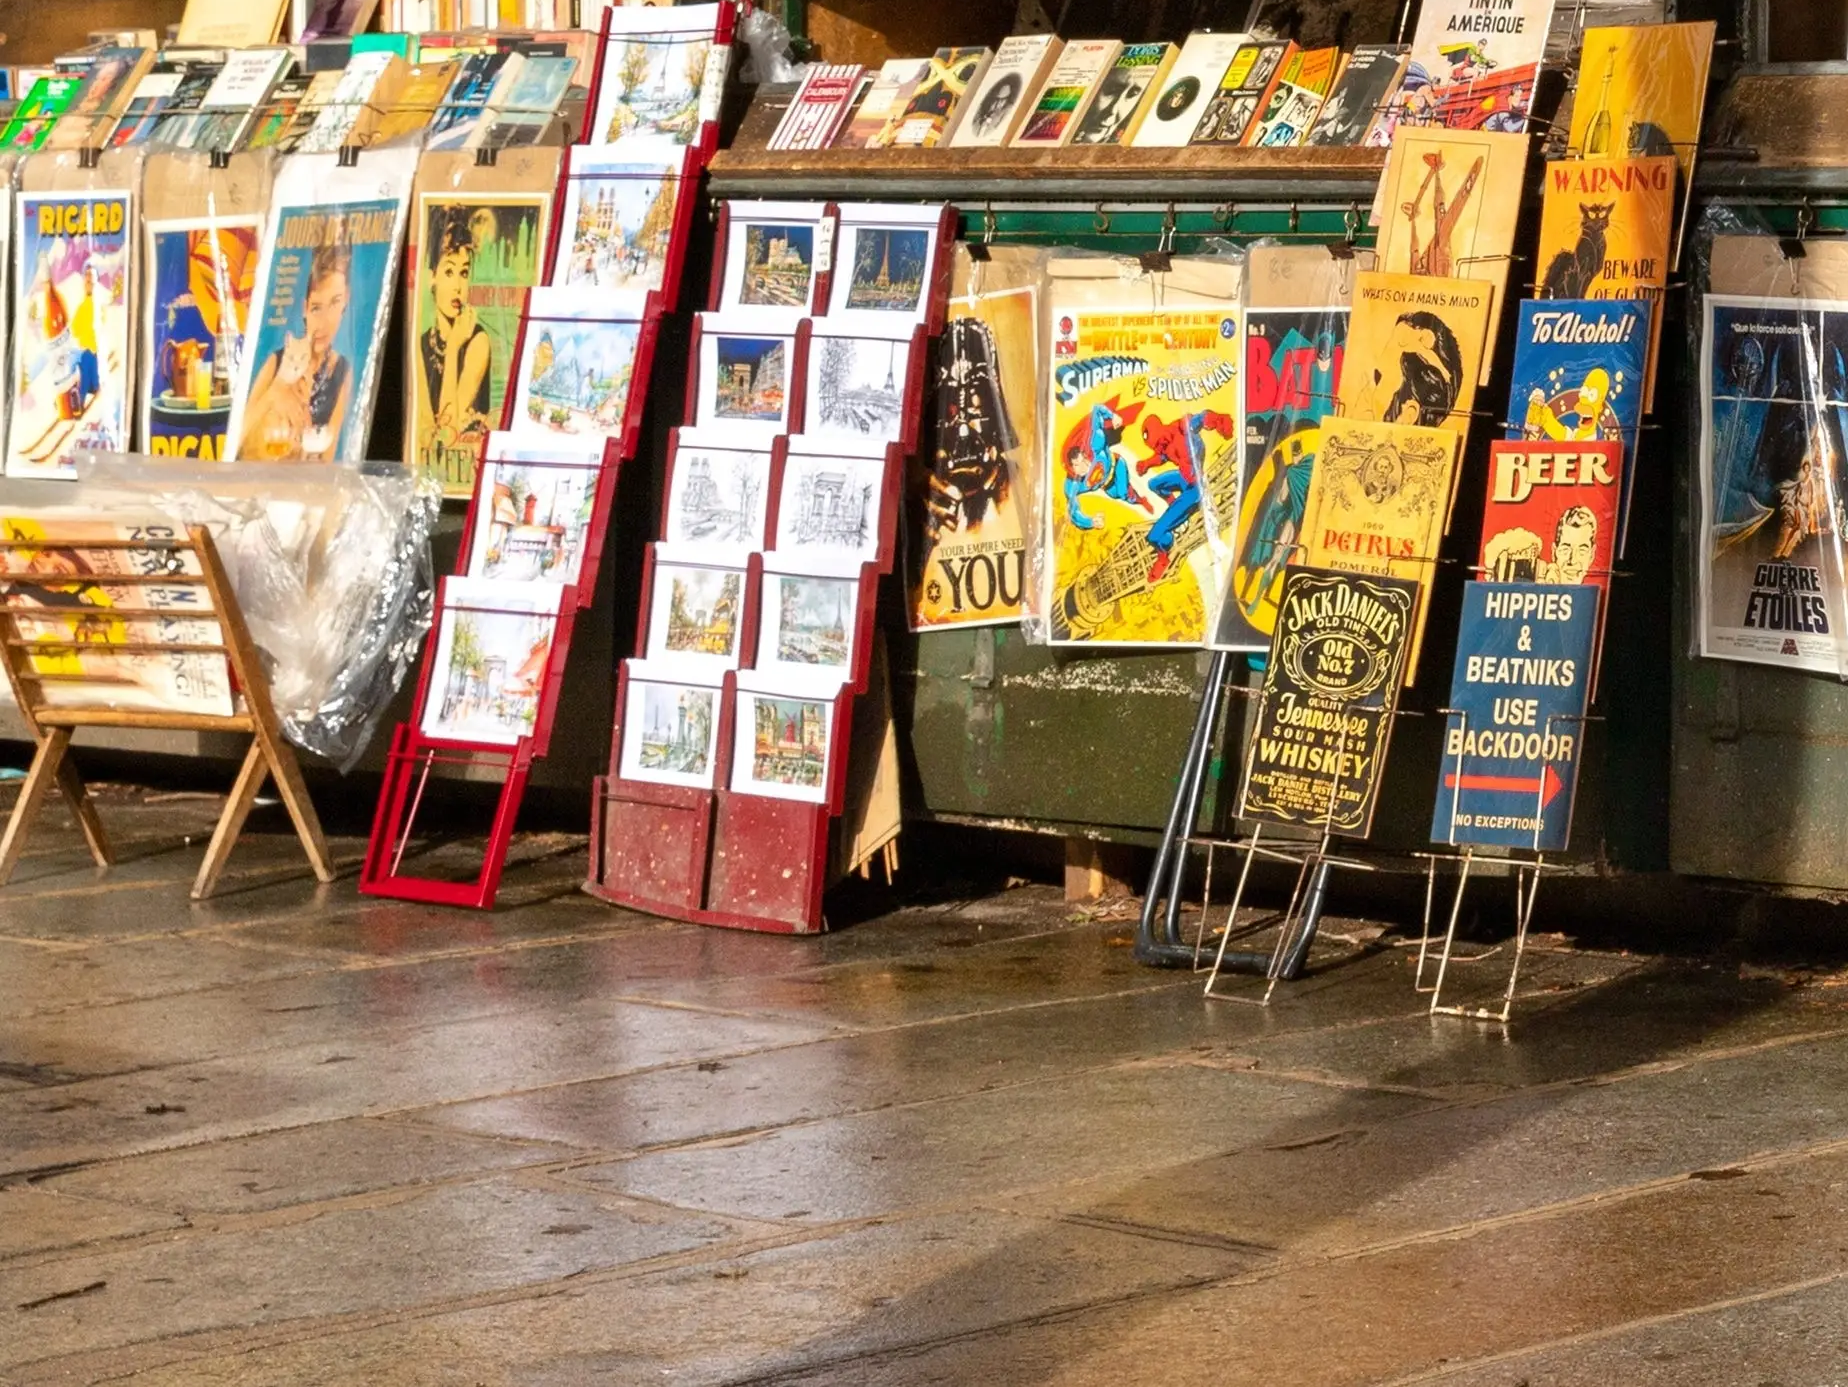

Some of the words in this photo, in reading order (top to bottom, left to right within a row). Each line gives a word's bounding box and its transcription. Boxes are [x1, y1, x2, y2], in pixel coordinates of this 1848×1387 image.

[1446, 11, 1525, 35] AMÉRIQUE
[1127, 44, 1161, 56] DORIS
[1553, 164, 1668, 194] WARNING
[37, 201, 125, 238] RICARD
[276, 213, 326, 250] JOURS
[1602, 258, 1657, 280] BEWARE
[1392, 291, 1408, 303] ON
[1416, 291, 1447, 307] MAN'S
[1448, 294, 1480, 309] MIND
[1092, 331, 1139, 352] BATTLE
[1532, 312, 1561, 344] To
[1553, 312, 1637, 344] Alcohol!
[1055, 355, 1150, 408] SUPERMAN
[1146, 361, 1239, 402] SPIDER-MAN
[1491, 451, 1615, 504] BEER
[939, 545, 967, 559] YOUR
[966, 542, 998, 556] EMPIRE
[937, 550, 1026, 615] YOU
[1329, 559, 1399, 577] POMEROL
[1753, 563, 1822, 592] GUERRE
[1287, 589, 1335, 632] JACK
[1334, 583, 1401, 645] DANIEL'S
[1484, 591, 1573, 622] HIPPIES
[1743, 587, 1830, 636] ÉTOILES
[1316, 616, 1340, 629] OLD
[1343, 618, 1368, 637] TIME
[1516, 624, 1533, 653] &
[1322, 638, 1355, 659] Old
[1316, 673, 1348, 687] BRAND
[1317, 655, 1356, 676] No.7
[1466, 656, 1576, 688] BEATNIKS
[1275, 691, 1370, 738] Tennessee
[1307, 696, 1345, 712] QUALITY
[1492, 697, 1539, 727] USE
[1272, 724, 1316, 744] SOUR
[1323, 734, 1367, 753] MASH
[1446, 729, 1574, 763] BACKDOOR
[1259, 736, 1371, 780] WHISKEY
[1250, 773, 1275, 786] JACK
[1277, 775, 1310, 793] DANIEL
[1455, 813, 1472, 827] NO
